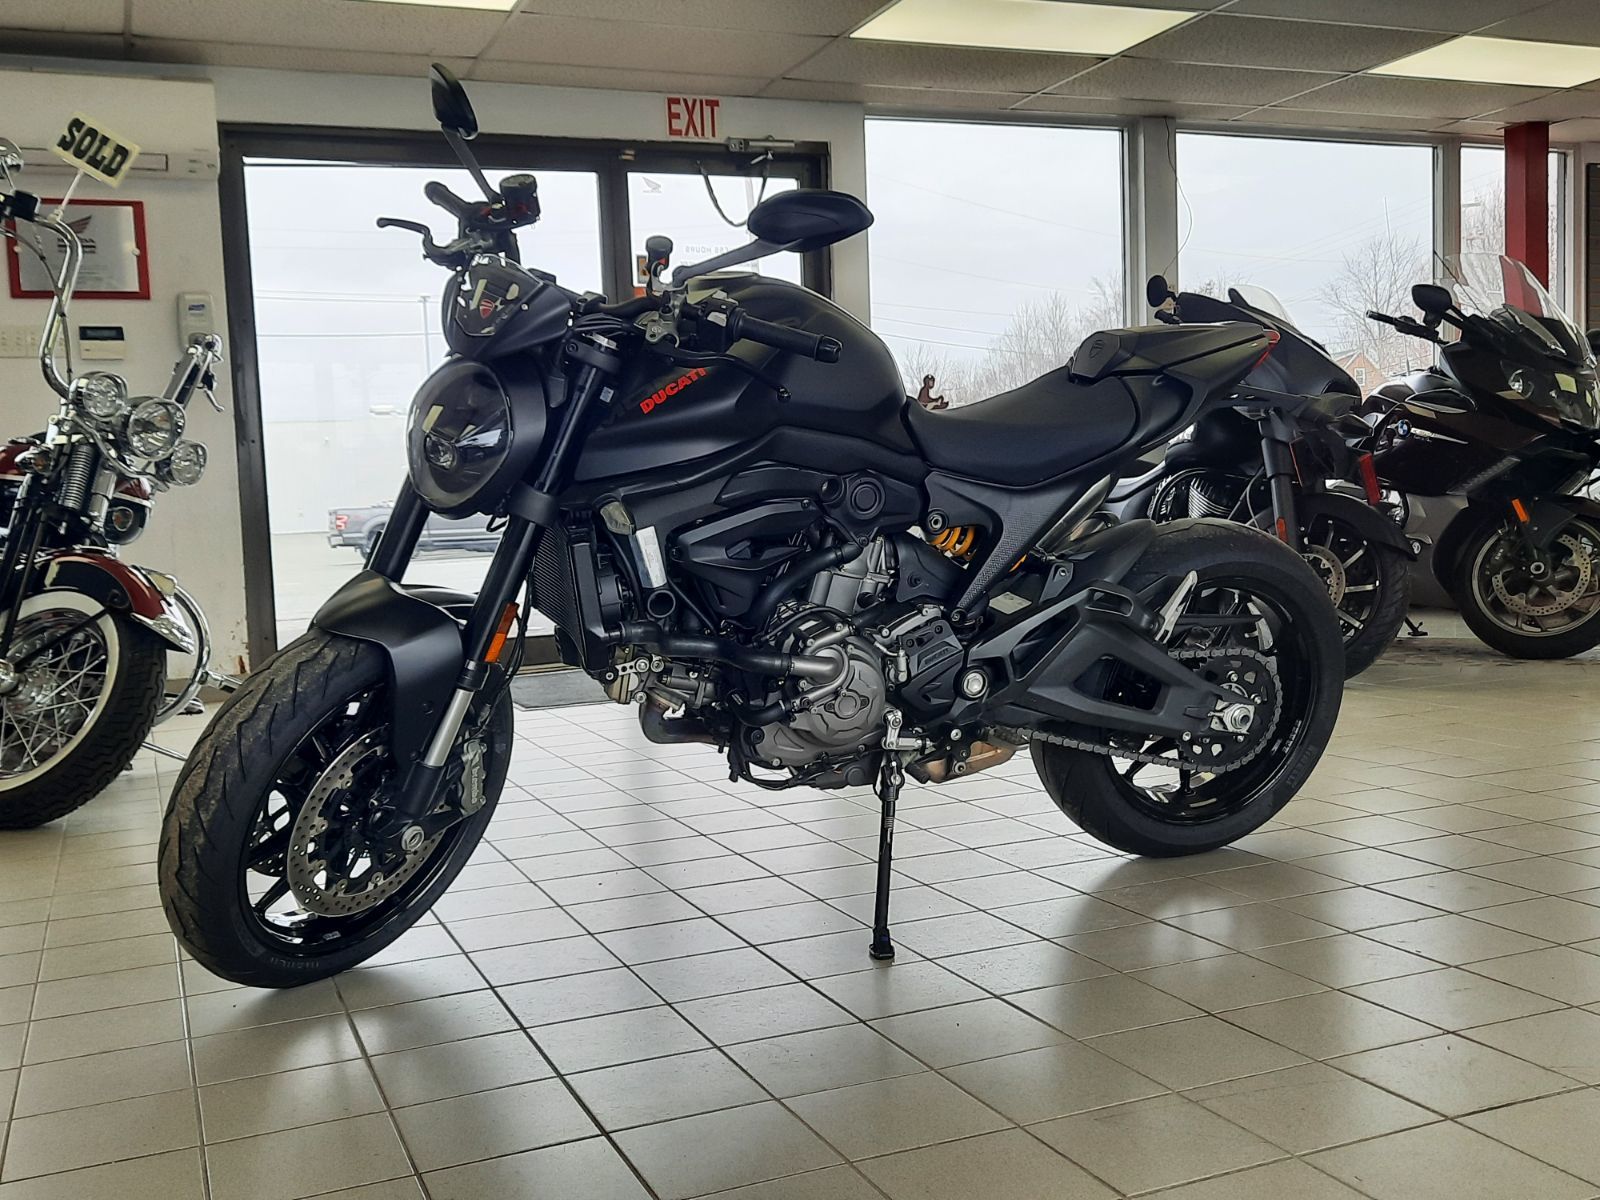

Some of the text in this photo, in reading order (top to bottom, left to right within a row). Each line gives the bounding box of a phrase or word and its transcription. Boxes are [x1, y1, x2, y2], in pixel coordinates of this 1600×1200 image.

[667, 97, 719, 137] EXIT
[57, 118, 129, 177] SOLD
[640, 367, 706, 414] DUCATI
[471, 765, 480, 805] brembo
